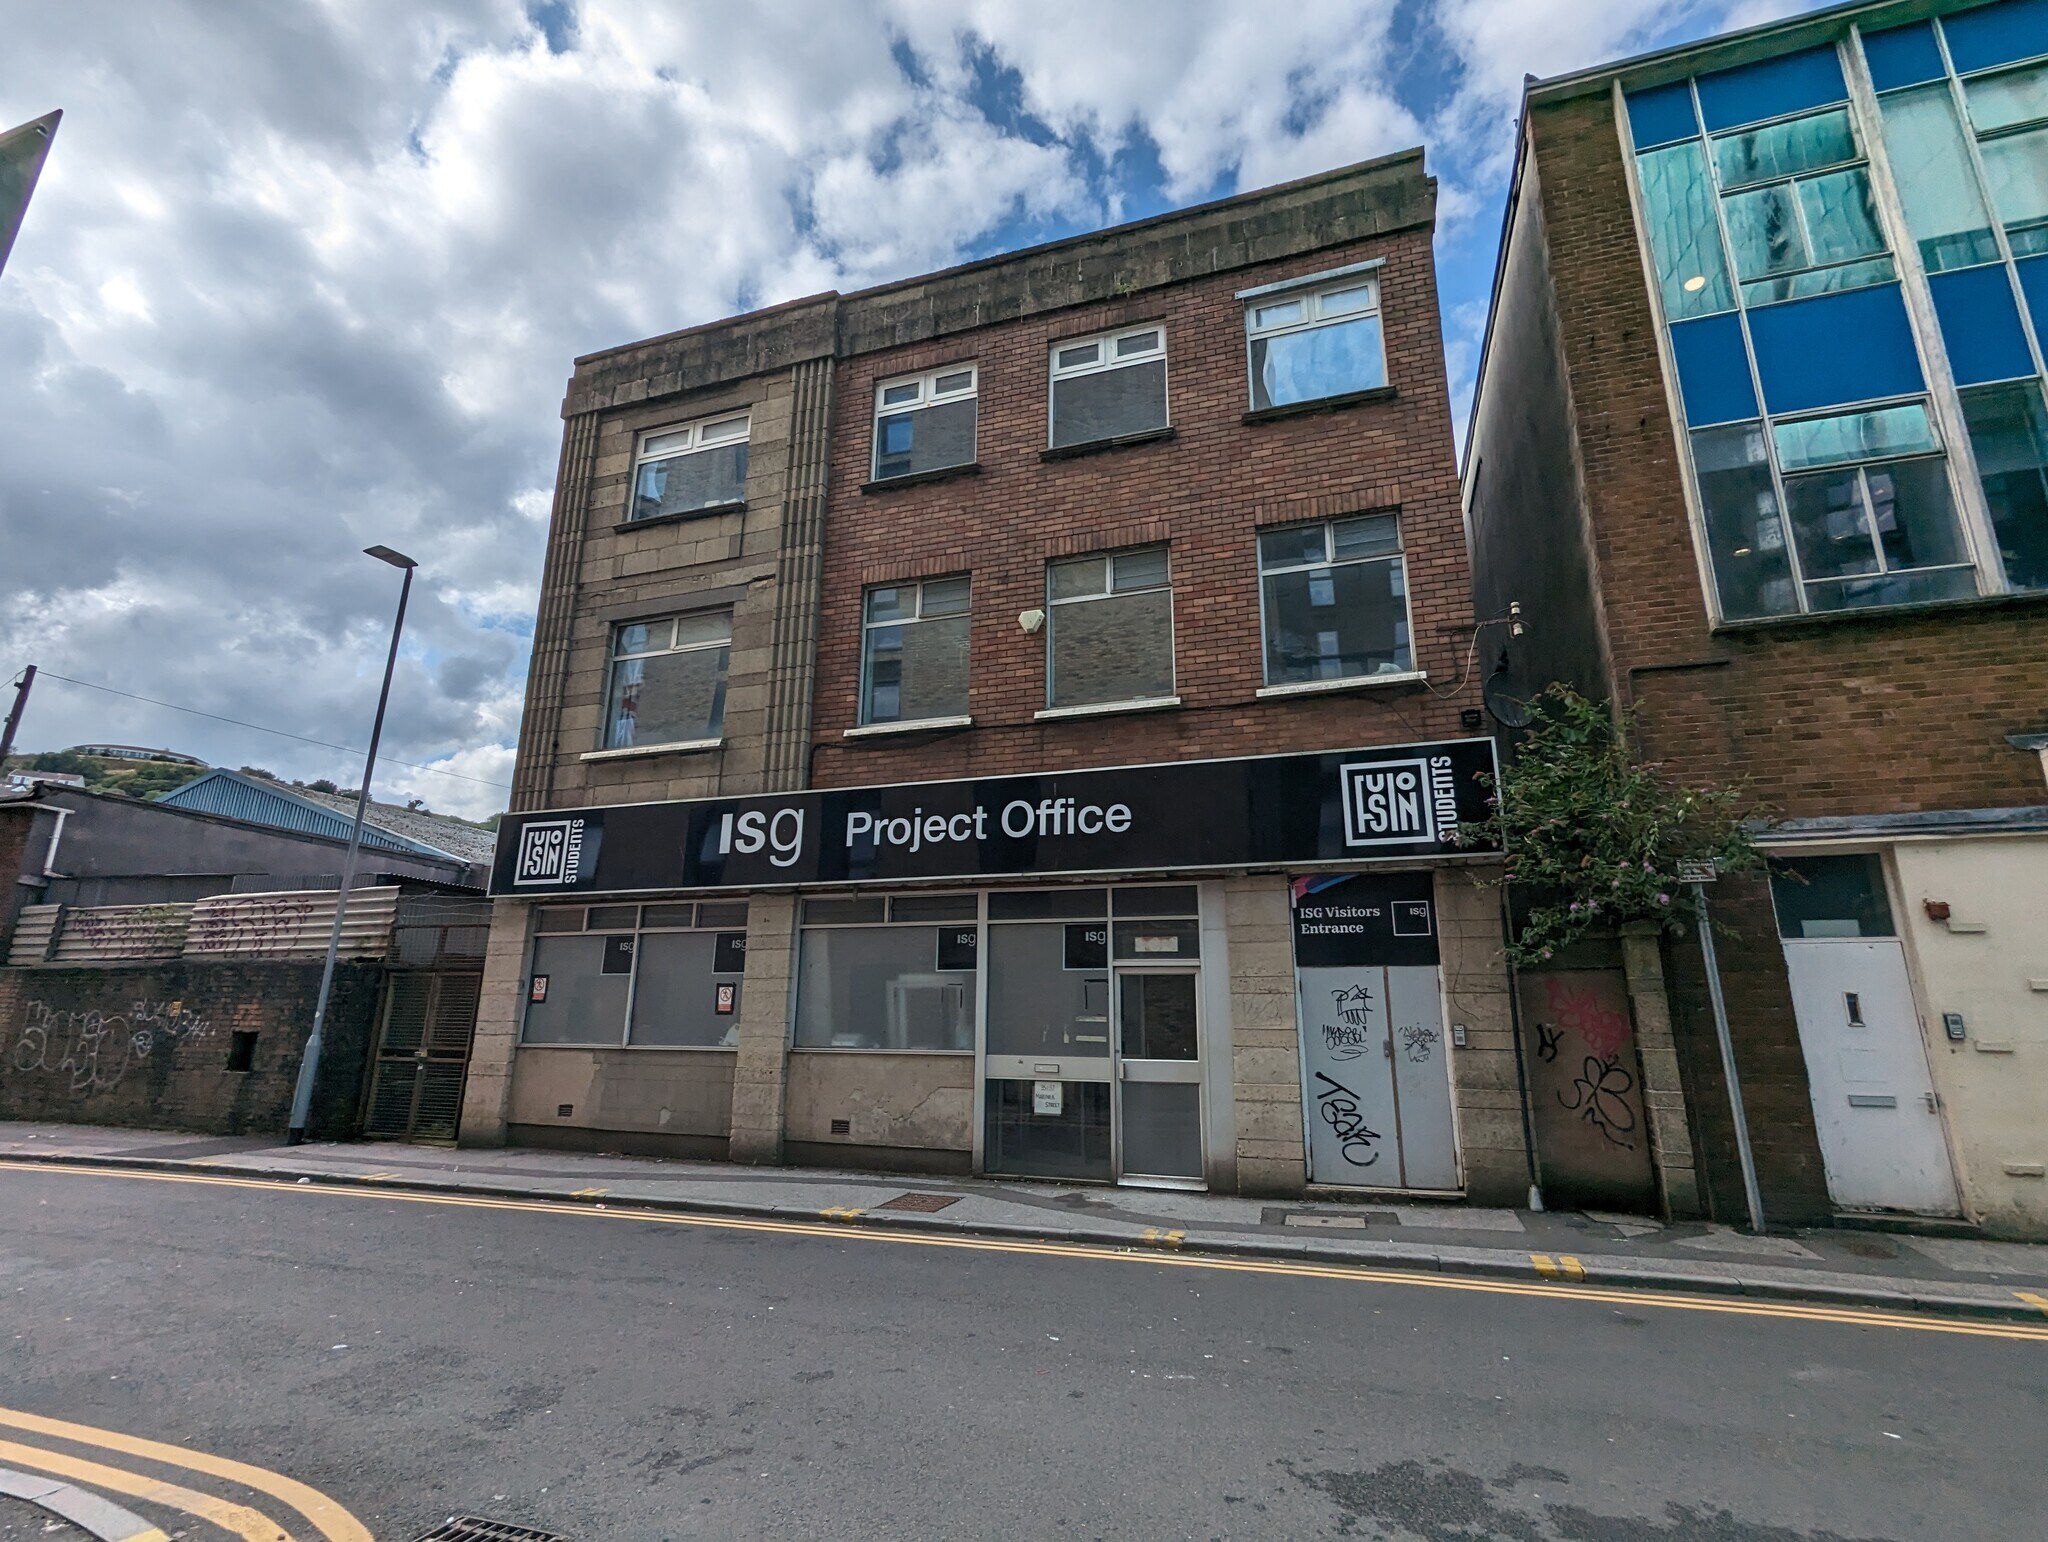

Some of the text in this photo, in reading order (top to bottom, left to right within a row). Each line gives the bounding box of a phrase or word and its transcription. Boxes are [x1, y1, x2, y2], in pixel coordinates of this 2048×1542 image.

[845, 805, 988, 853] Project
[1000, 797, 1132, 838] Office
[1430, 756, 1458, 842] STUDENTS
[564, 818, 585, 884] STUDENTS
[1299, 905, 1381, 919] ISG Visitors
[1301, 923, 1365, 935] Entrance
